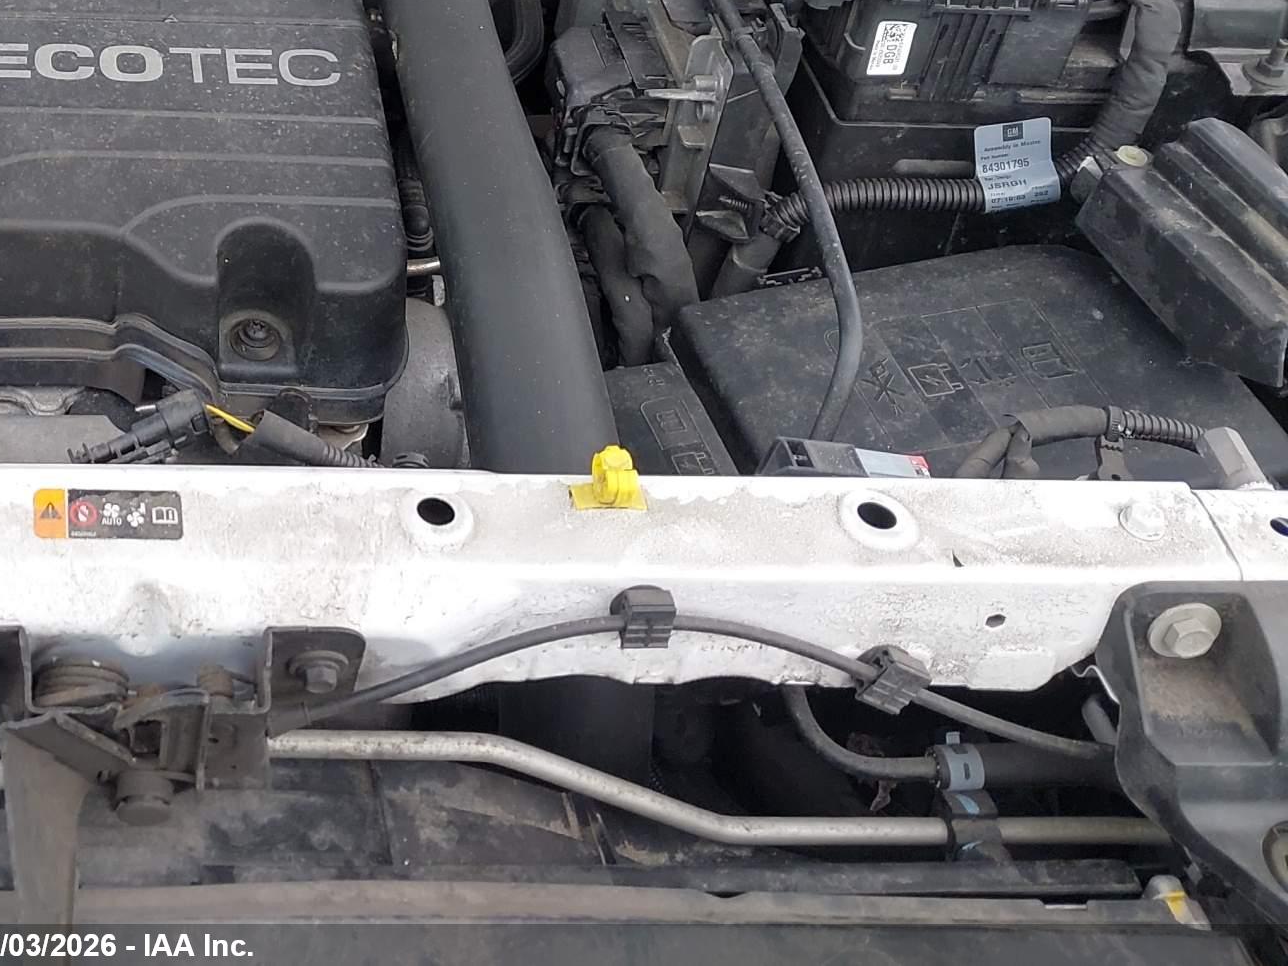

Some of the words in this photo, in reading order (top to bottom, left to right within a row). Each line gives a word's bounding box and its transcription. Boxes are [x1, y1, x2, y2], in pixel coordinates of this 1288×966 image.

[882, 44, 898, 64] DGB
[982, 157, 1030, 174] 84301795
[101, 516, 122, 526] AUTO
